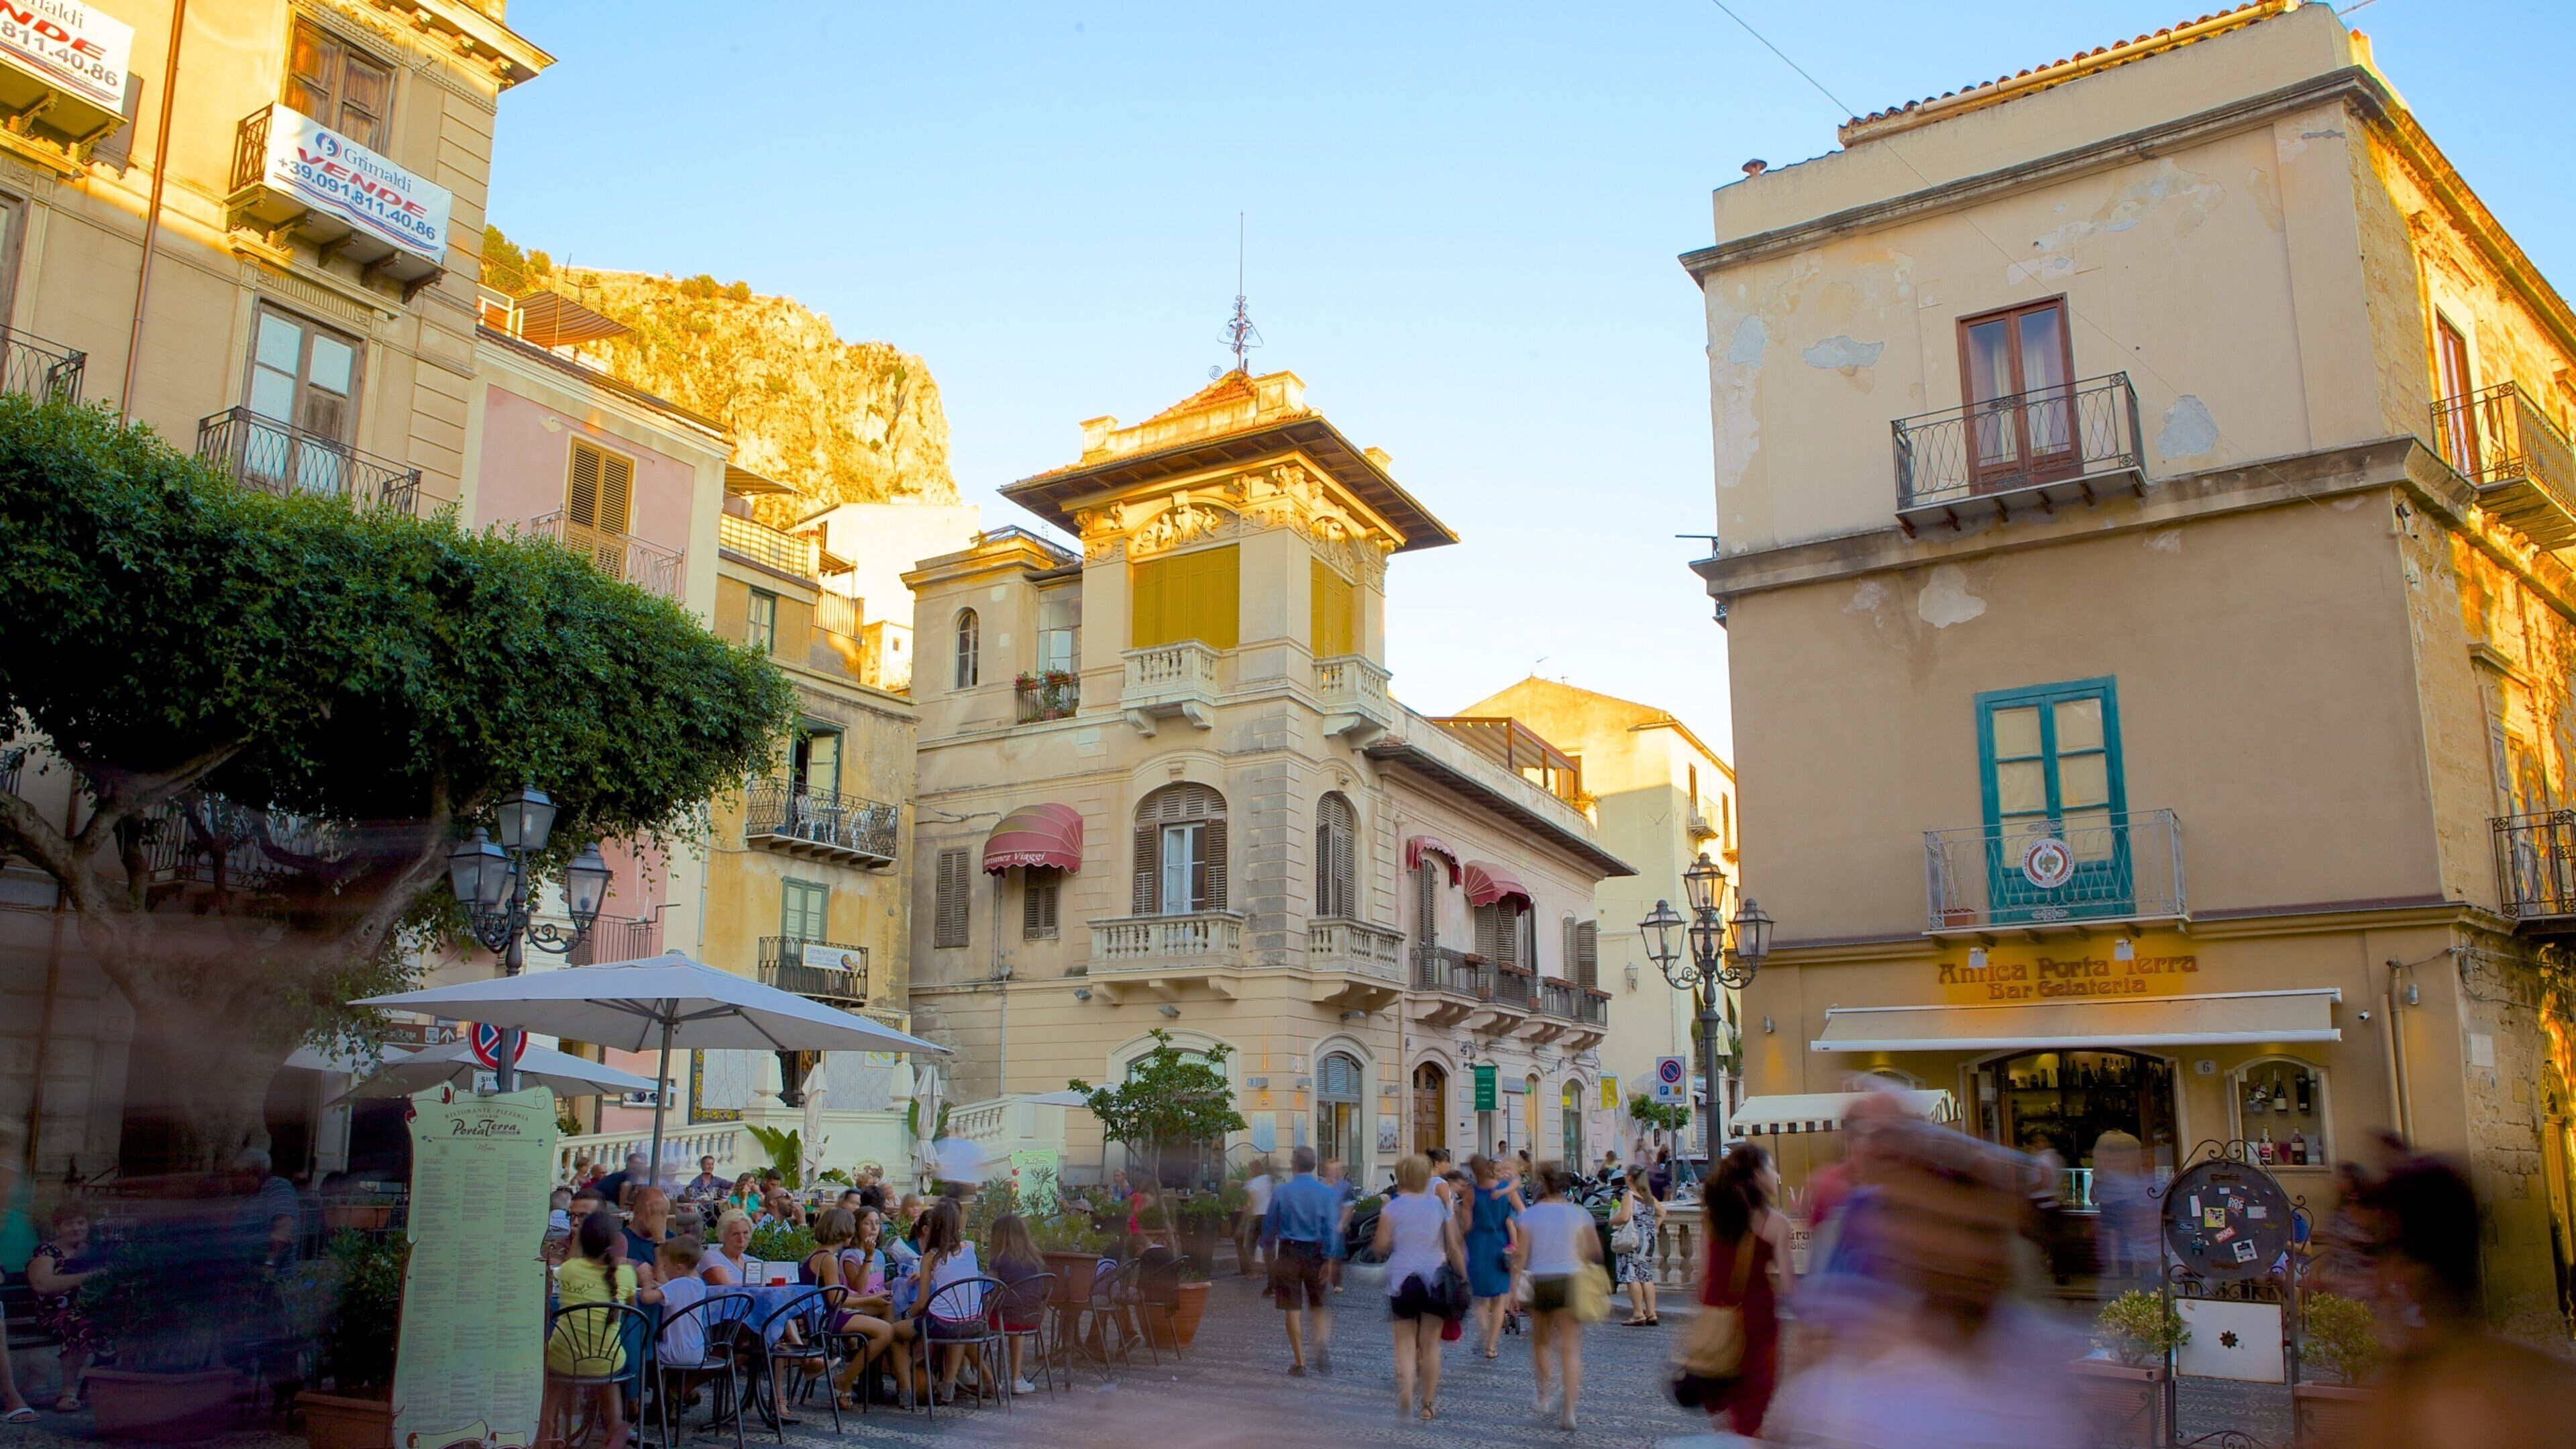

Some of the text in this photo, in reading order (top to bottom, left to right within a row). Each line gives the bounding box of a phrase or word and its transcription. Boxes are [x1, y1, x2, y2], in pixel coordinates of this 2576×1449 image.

[297, 147, 427, 219] VENDE
[344, 148, 412, 193] Grimaldi
[278, 158, 436, 240] +39.091.811.40.86
[1014, 852, 1046, 863] Viaggi
[1938, 953, 2200, 985] Antica Porta Terra
[1986, 976, 2147, 1000] Bar Gelateria
[2202, 1062, 2210, 1073] 6
[444, 1107, 529, 1122] RISTORANTE PIZZERIA
